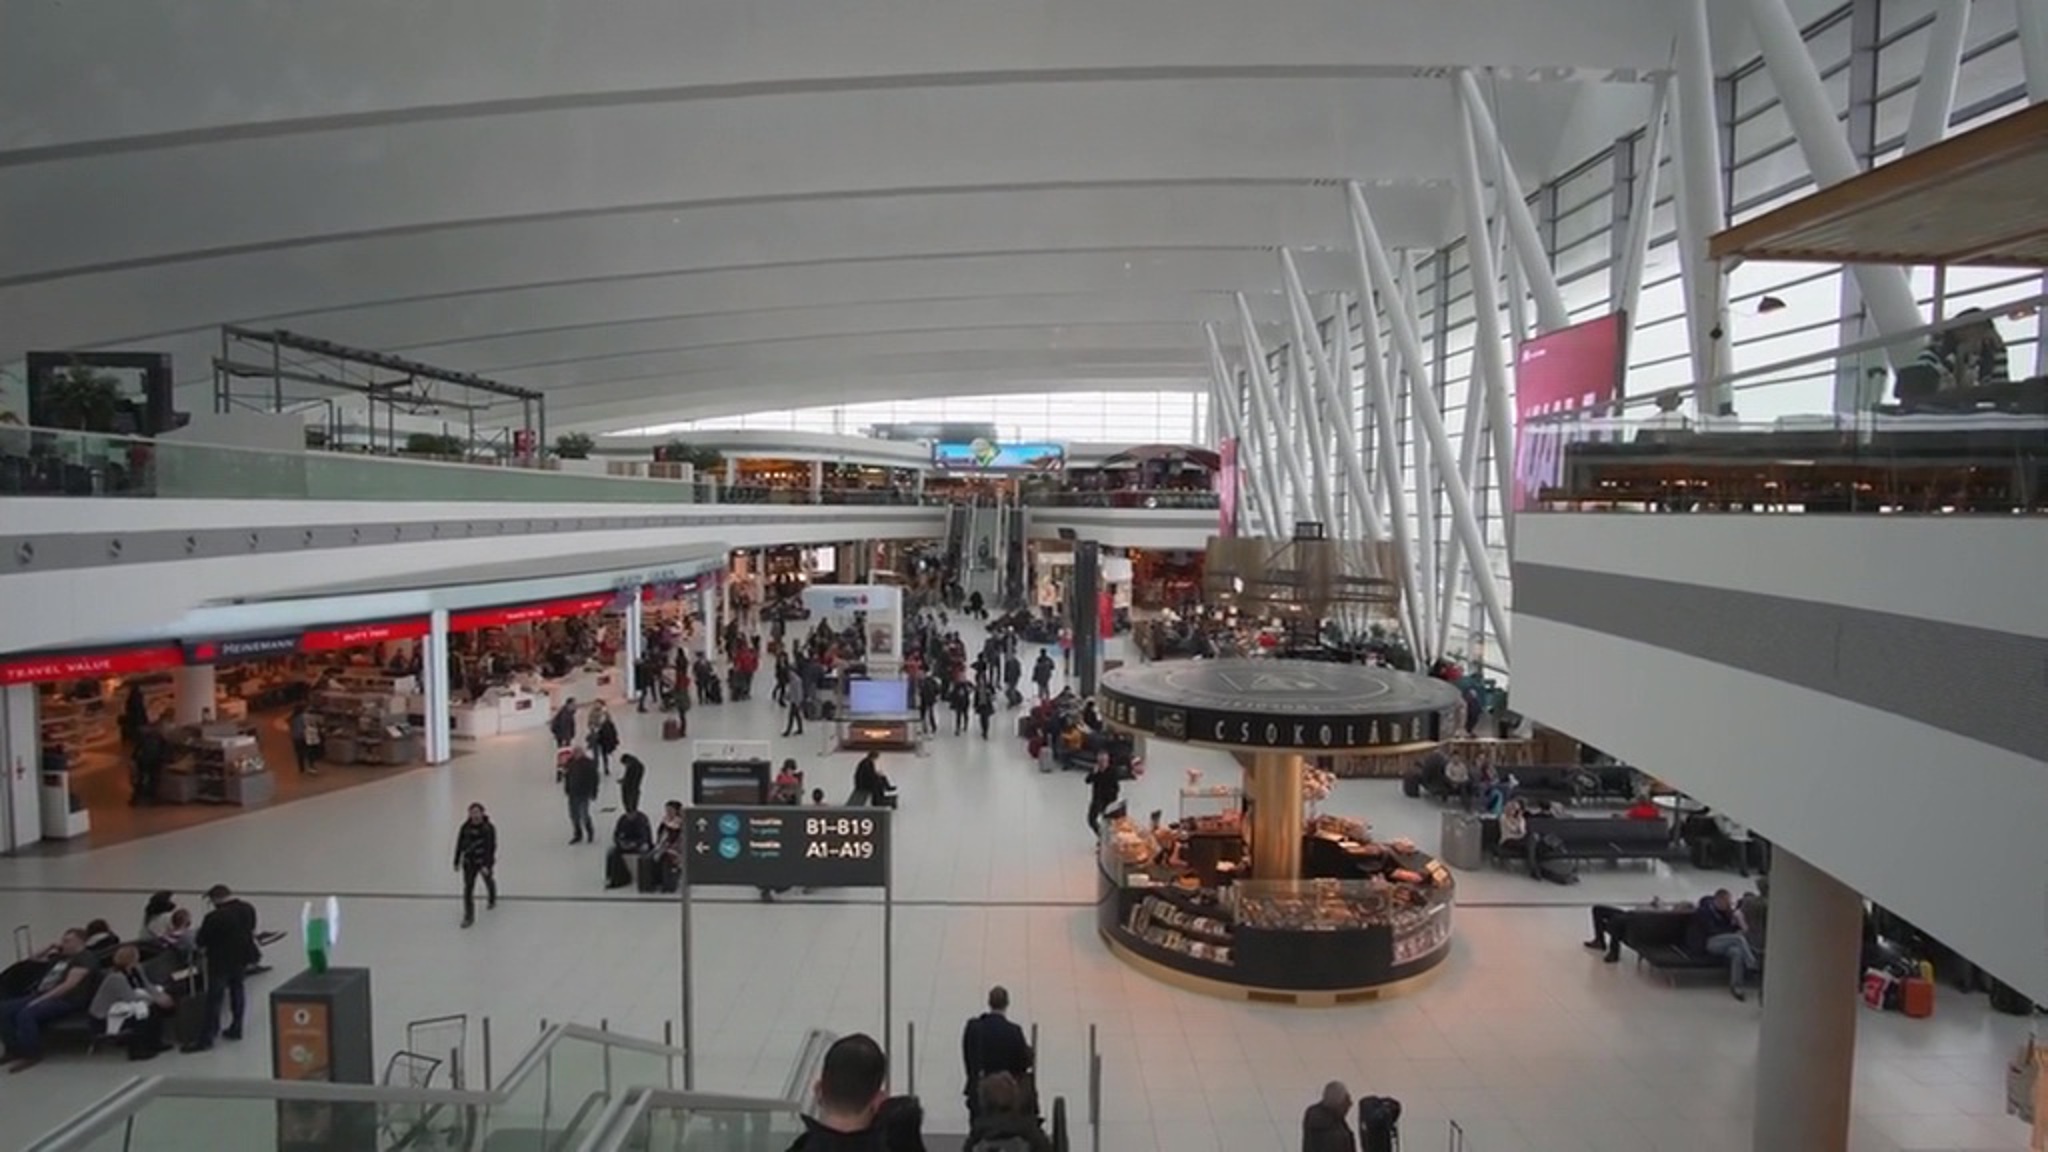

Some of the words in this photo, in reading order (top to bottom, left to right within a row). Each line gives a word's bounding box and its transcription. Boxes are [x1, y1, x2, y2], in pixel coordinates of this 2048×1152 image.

[222, 640, 294, 655] HEINEMANN
[8, 664, 61, 678] TRAVEL
[66, 659, 111, 672] VALUE
[806, 818, 873, 835] B1-B19
[806, 841, 873, 859] A1-A19
